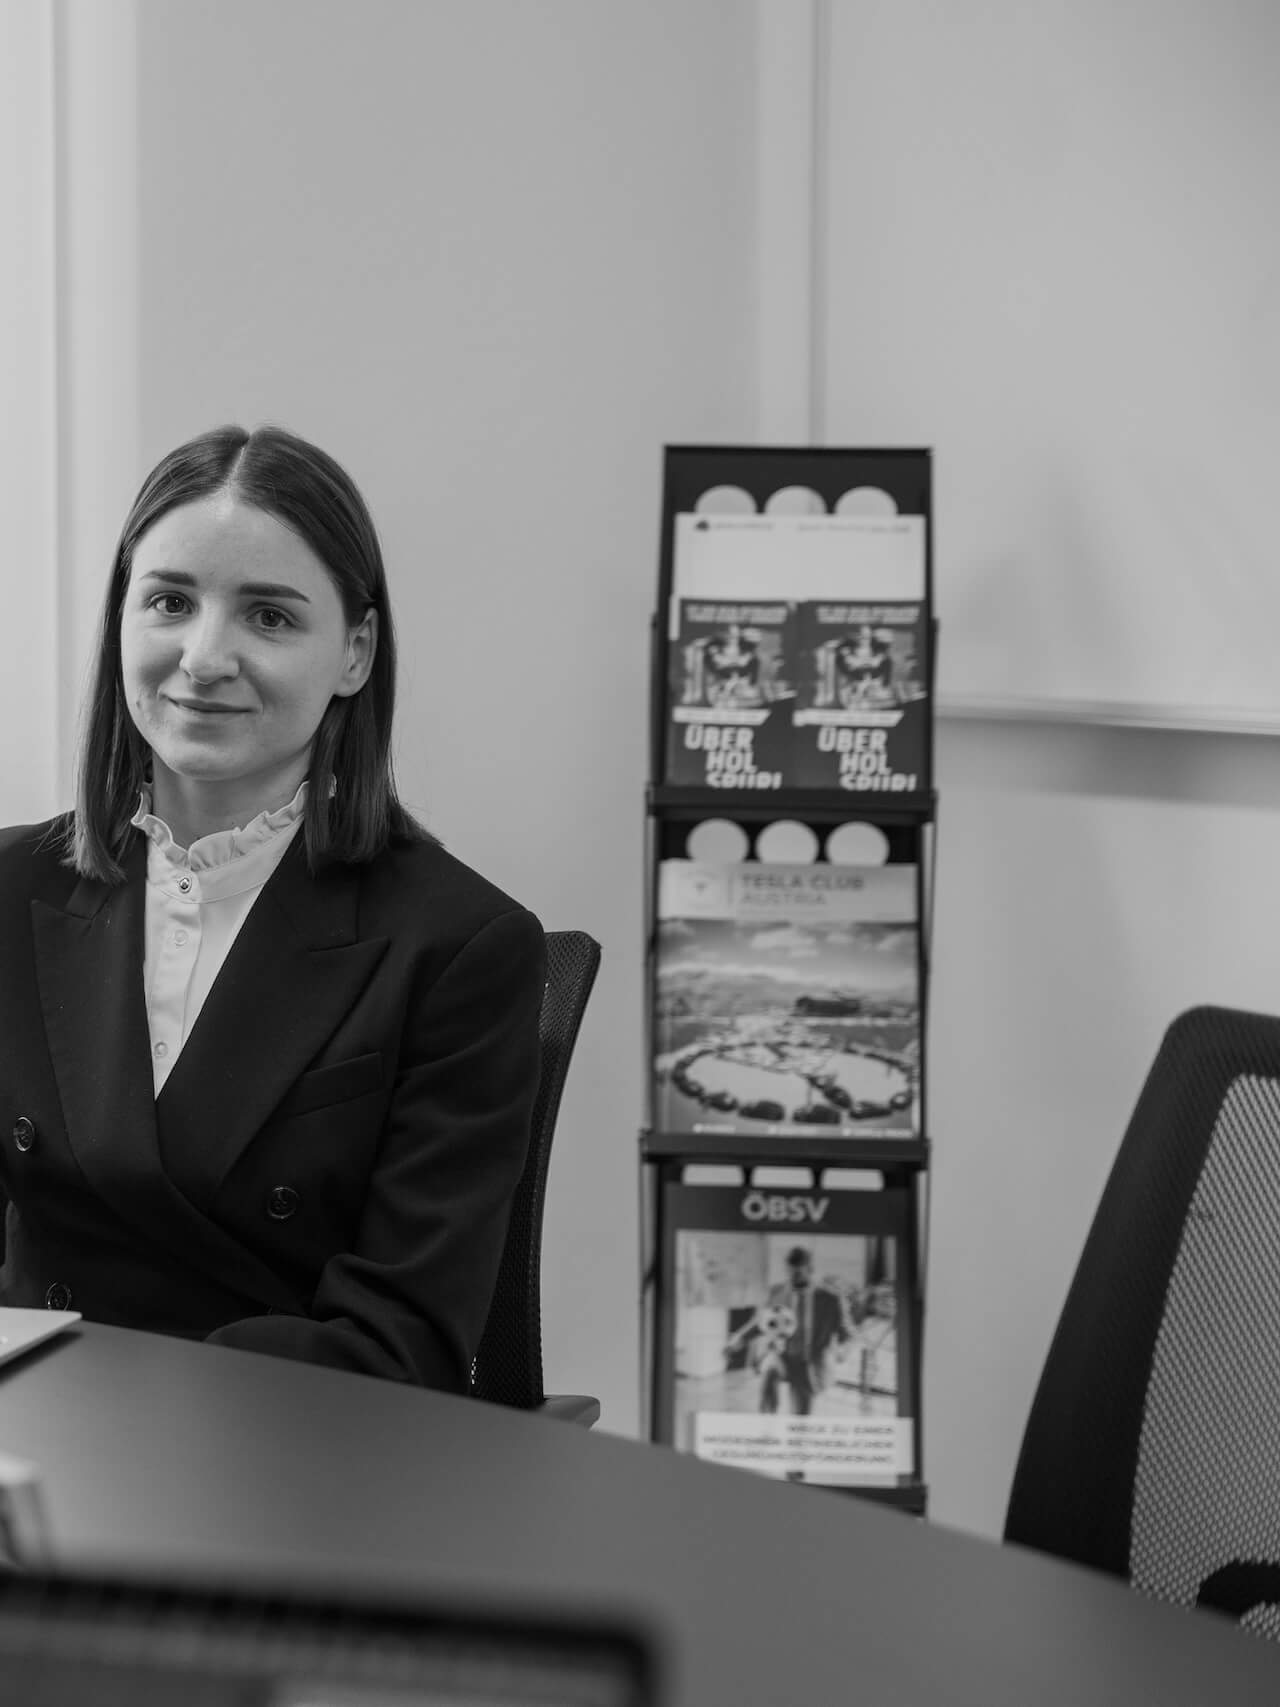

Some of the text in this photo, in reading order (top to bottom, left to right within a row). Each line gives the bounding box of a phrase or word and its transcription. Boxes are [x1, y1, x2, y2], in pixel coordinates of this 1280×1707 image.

[705, 751, 758, 774] HOL
[839, 752, 893, 776] HOL
[742, 873, 865, 891] TESLA CLUB
[741, 1190, 831, 1224] ÖBSV
